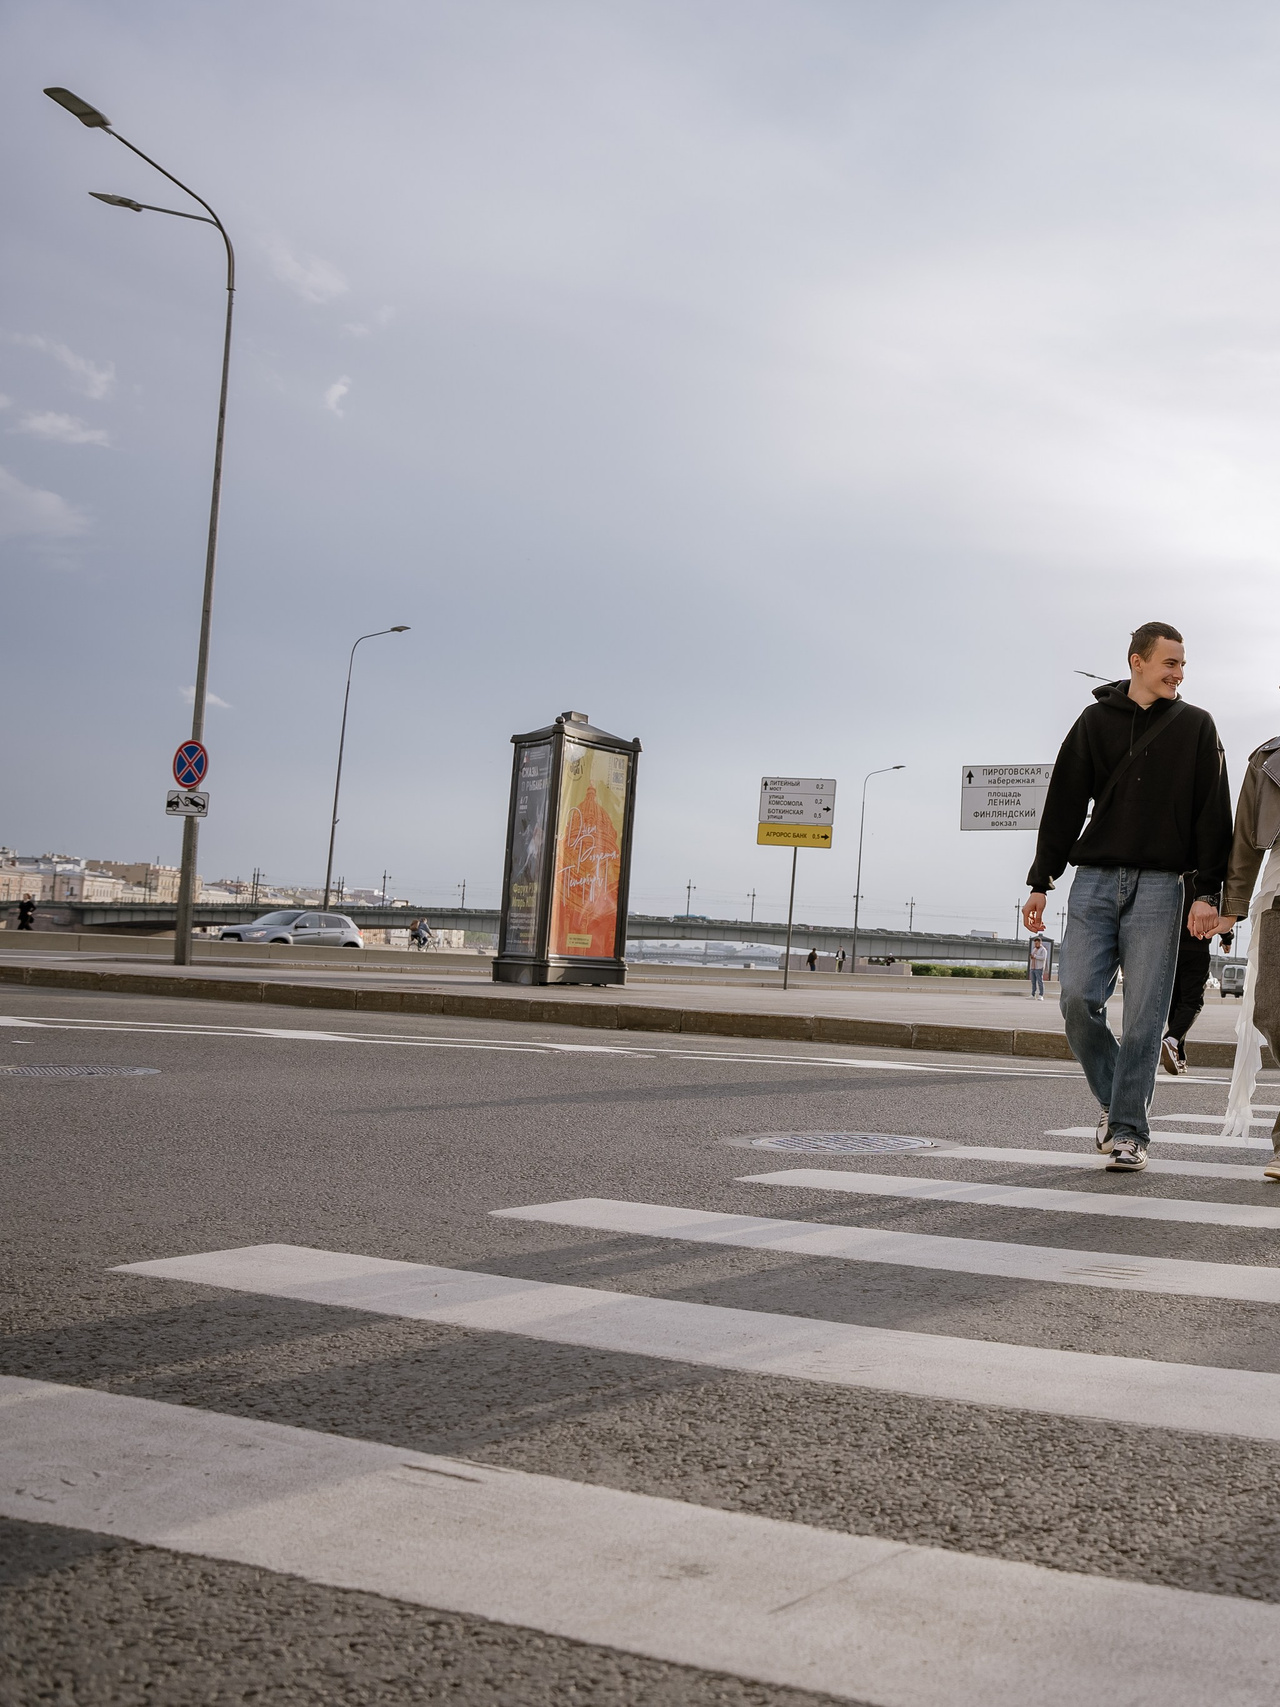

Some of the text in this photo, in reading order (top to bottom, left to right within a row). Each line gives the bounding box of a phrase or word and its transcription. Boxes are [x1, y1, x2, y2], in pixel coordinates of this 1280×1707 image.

[982, 767, 1042, 776] ПИРОГОВСКАЯ
[987, 777, 1035, 785] набережная
[987, 798, 1022, 806] ЛЕНИНА
[972, 808, 1036, 818] ФИНЛЯНДСКИЙ
